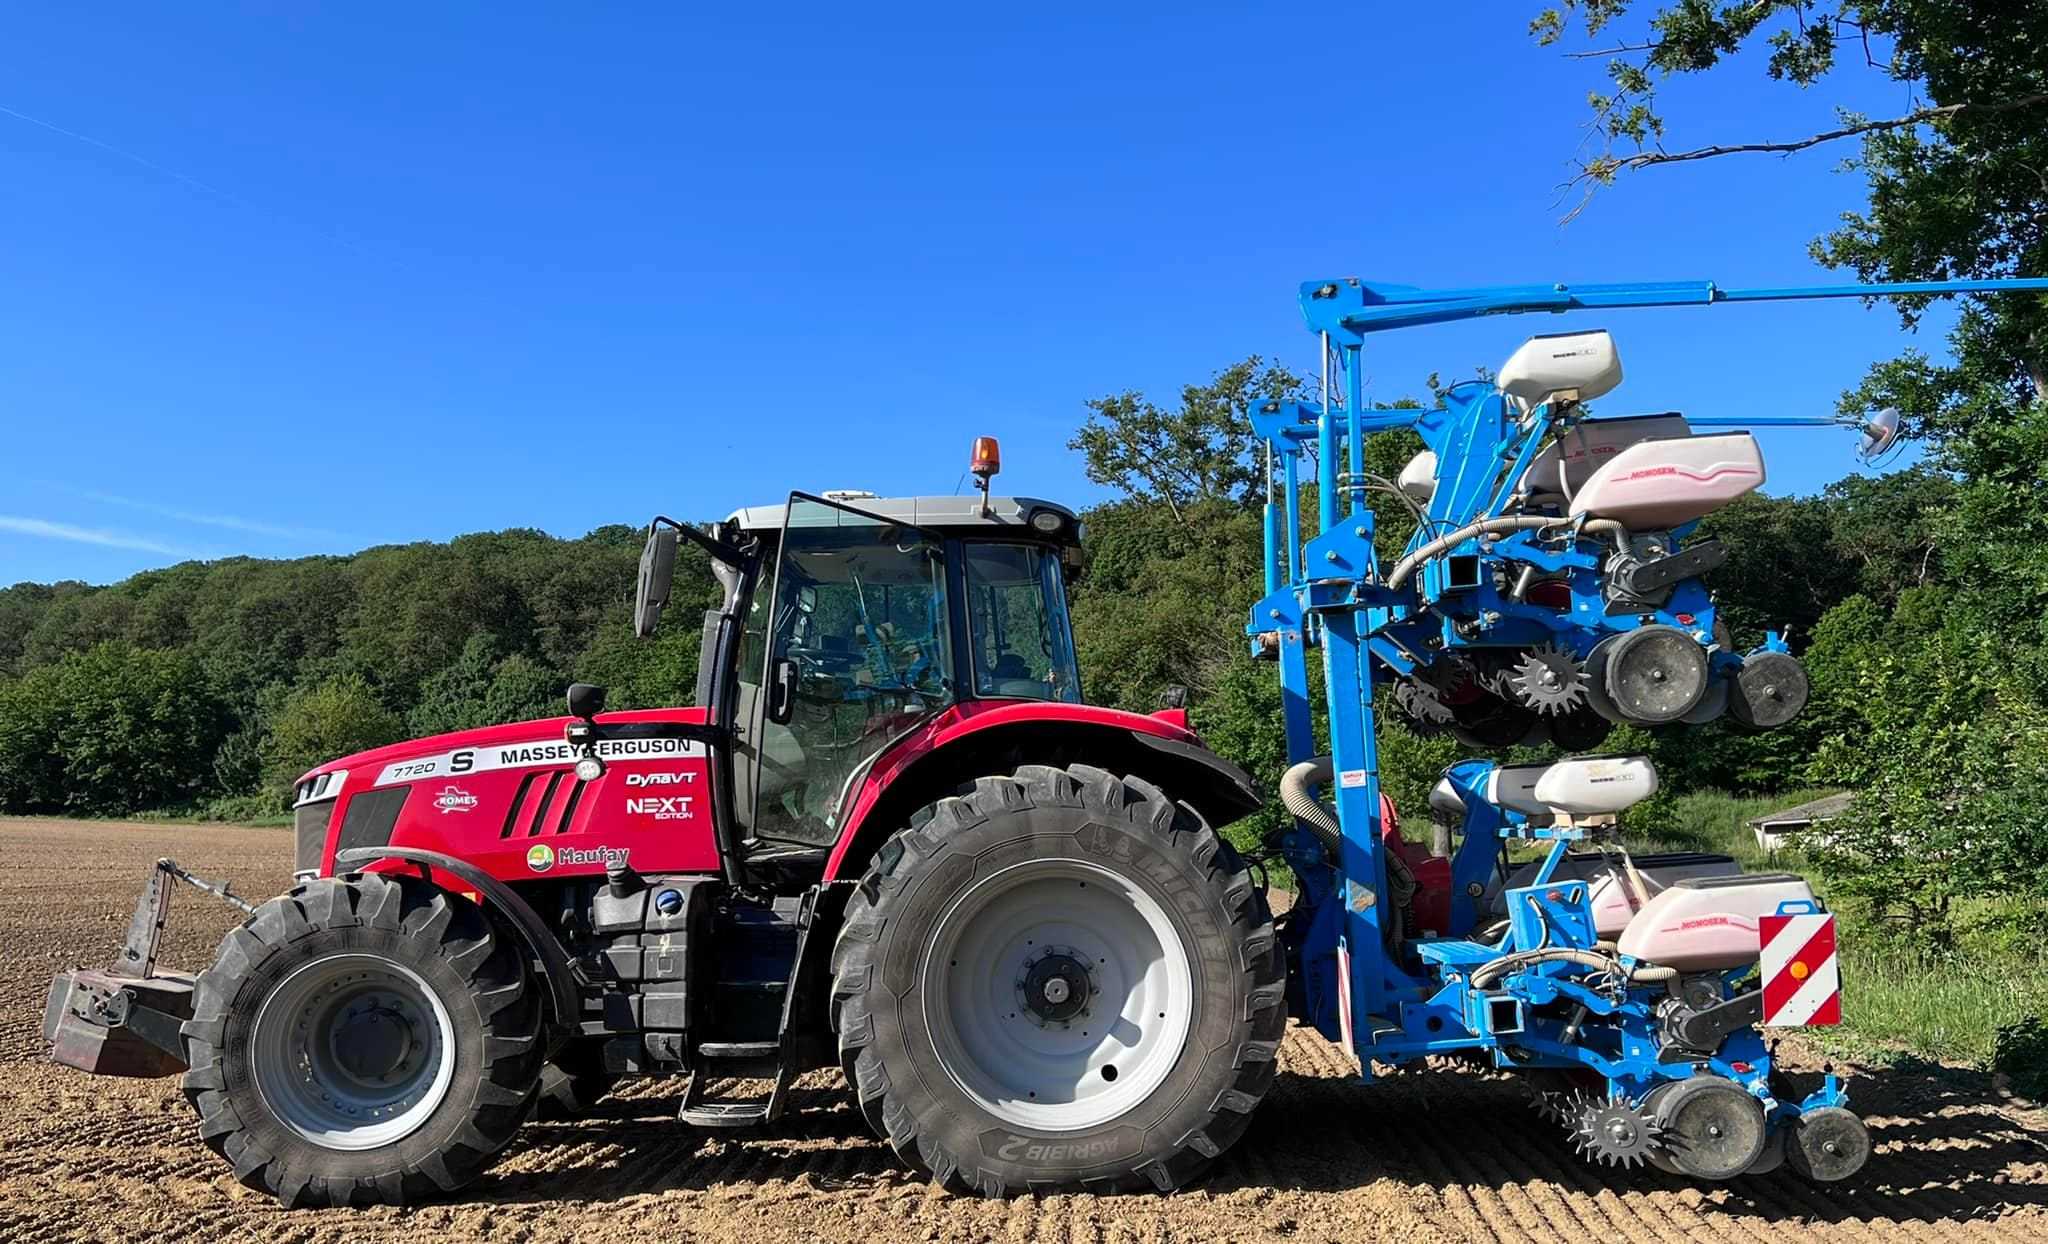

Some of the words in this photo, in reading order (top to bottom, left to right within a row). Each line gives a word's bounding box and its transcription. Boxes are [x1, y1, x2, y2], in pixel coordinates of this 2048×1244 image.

[393, 762, 437, 778] 7720
[450, 751, 474, 772] S
[501, 743, 581, 764] MASSEY
[589, 739, 692, 756] ERGUSON
[626, 796, 693, 814] NEXT
[655, 811, 693, 820] EDITION
[558, 845, 630, 865] Maufay
[998, 1134, 1031, 1161] 2
[1025, 1135, 1120, 1161] AGRIBIB
